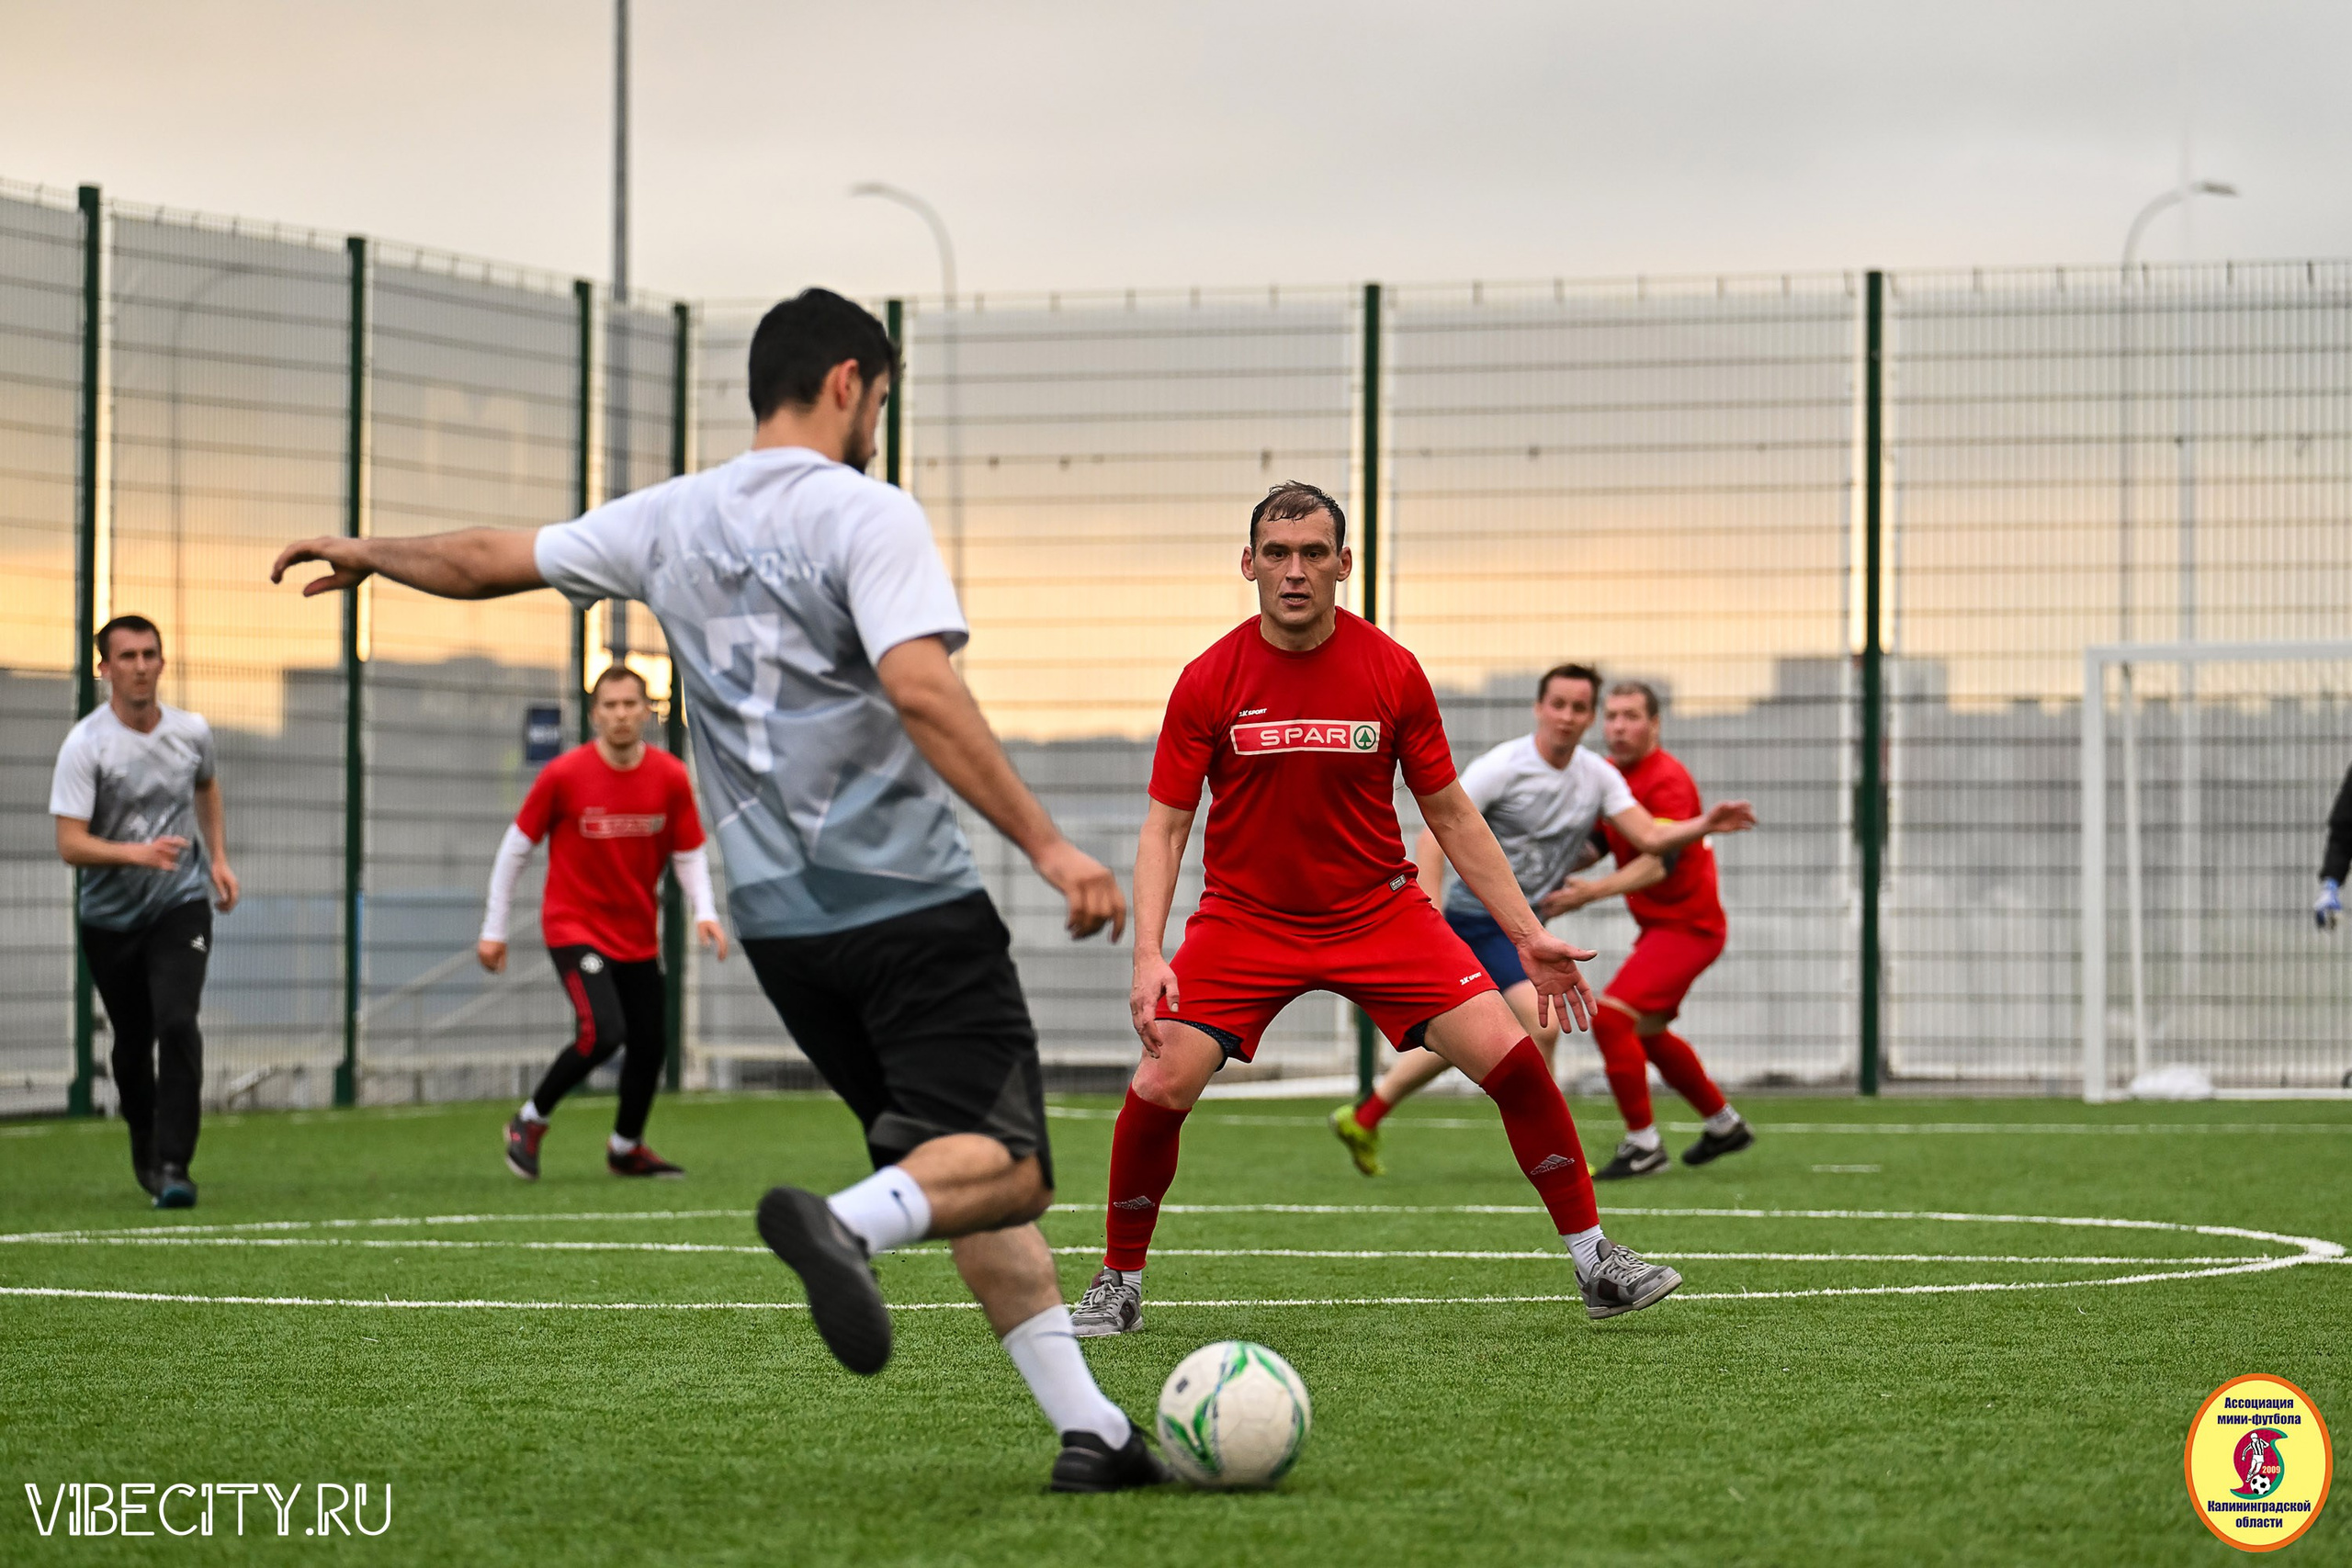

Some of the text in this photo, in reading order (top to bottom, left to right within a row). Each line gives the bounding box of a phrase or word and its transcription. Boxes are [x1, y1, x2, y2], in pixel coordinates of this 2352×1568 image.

[705, 612, 781, 773] 7
[1260, 727, 1347, 747] SPAR
[1530, 1157, 1575, 1176] adidas
